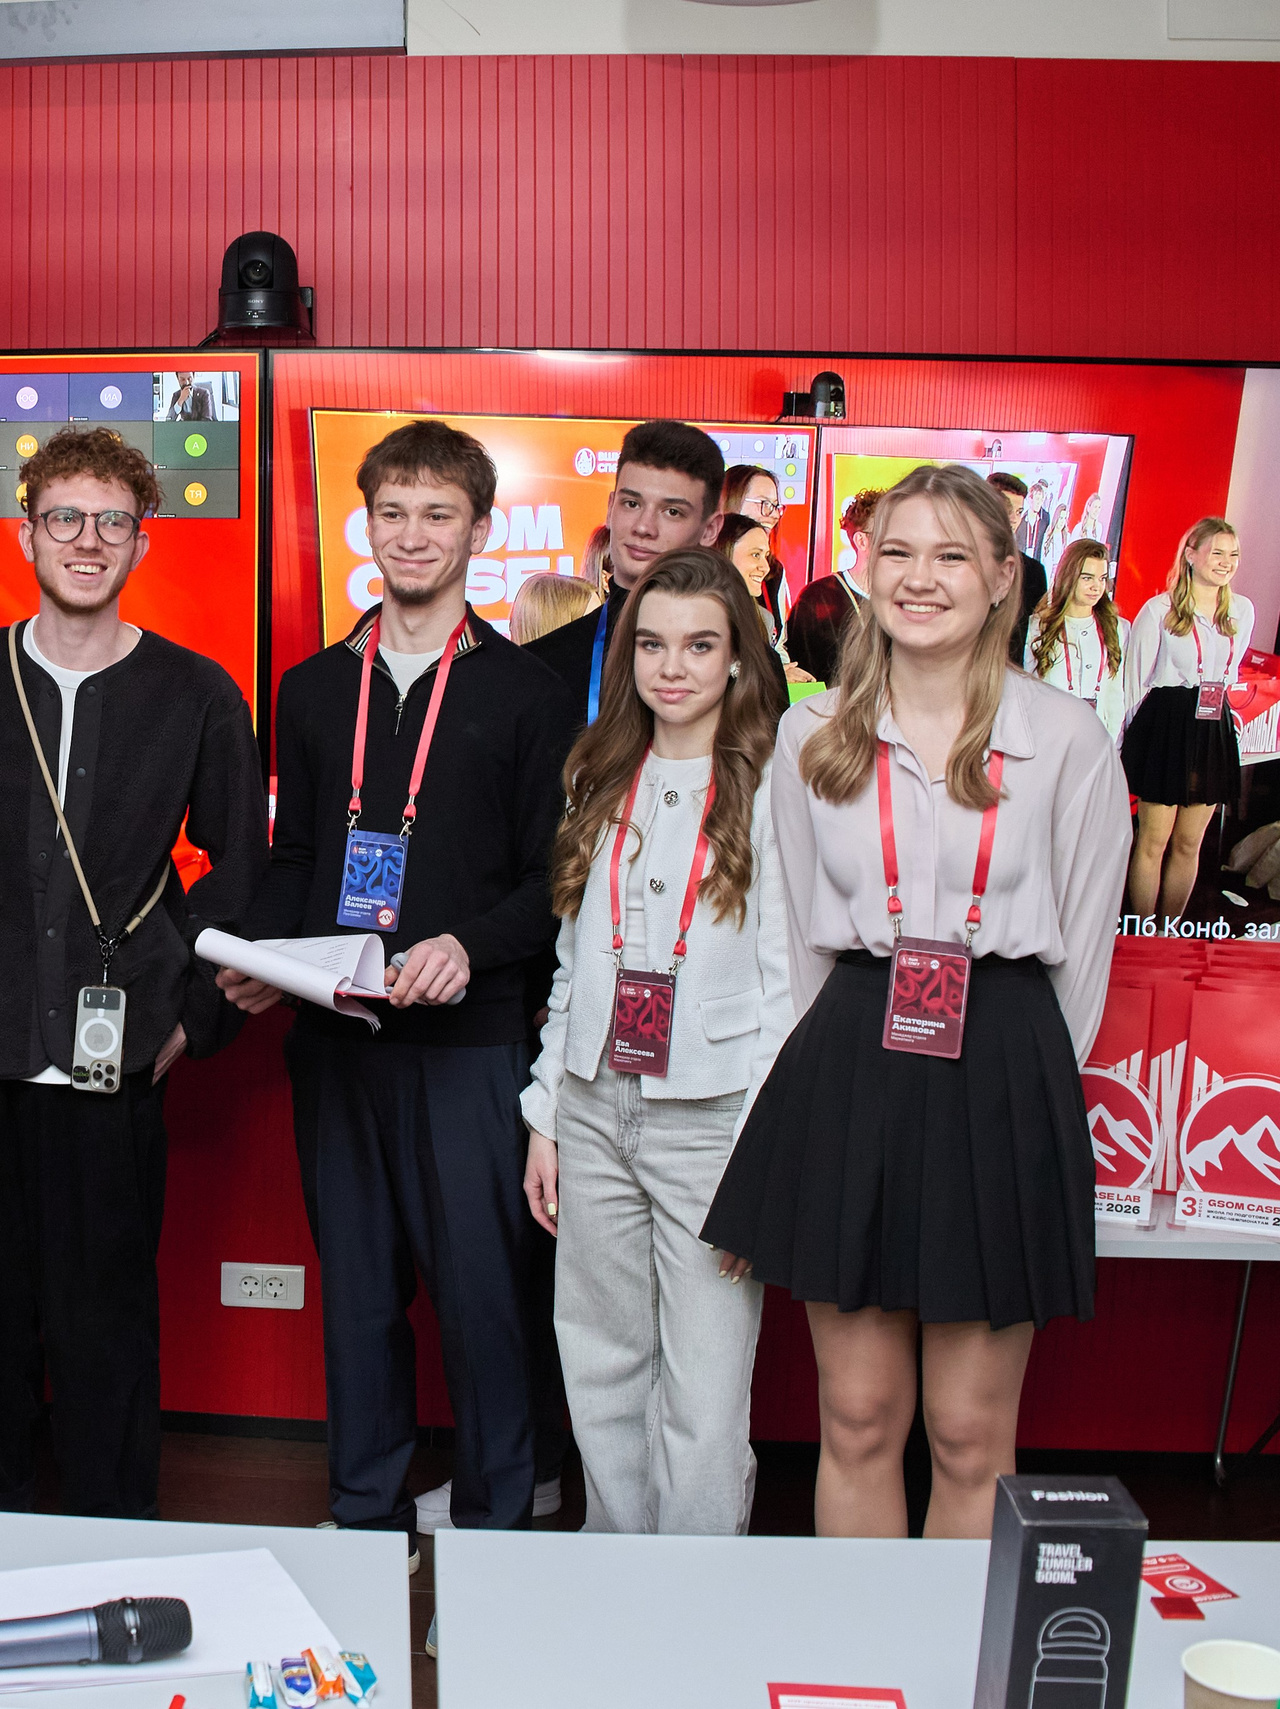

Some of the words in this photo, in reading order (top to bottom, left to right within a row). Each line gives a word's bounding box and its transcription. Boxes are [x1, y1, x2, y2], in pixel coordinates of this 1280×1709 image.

[20, 442, 34, 450] НИ
[189, 489, 202, 499] ТЯ
[345, 895, 387, 907] Александр
[1164, 916, 1236, 940] Конф.
[893, 1014, 946, 1029] Екатерина
[892, 1022, 936, 1035] Акимова
[615, 1039, 630, 1048] Ева
[614, 1046, 655, 1058] Алексеева
[1116, 1193, 1141, 1203] LAB
[1106, 1203, 1141, 1215] 2026
[1181, 1196, 1197, 1217] 3
[1208, 1199, 1245, 1211] GSOM
[1246, 1203, 1280, 1215] CASE
[1031, 1490, 1110, 1502] Fashion
[1038, 1543, 1083, 1558] TRAVEL
[1038, 1556, 1094, 1572] TUMBLER
